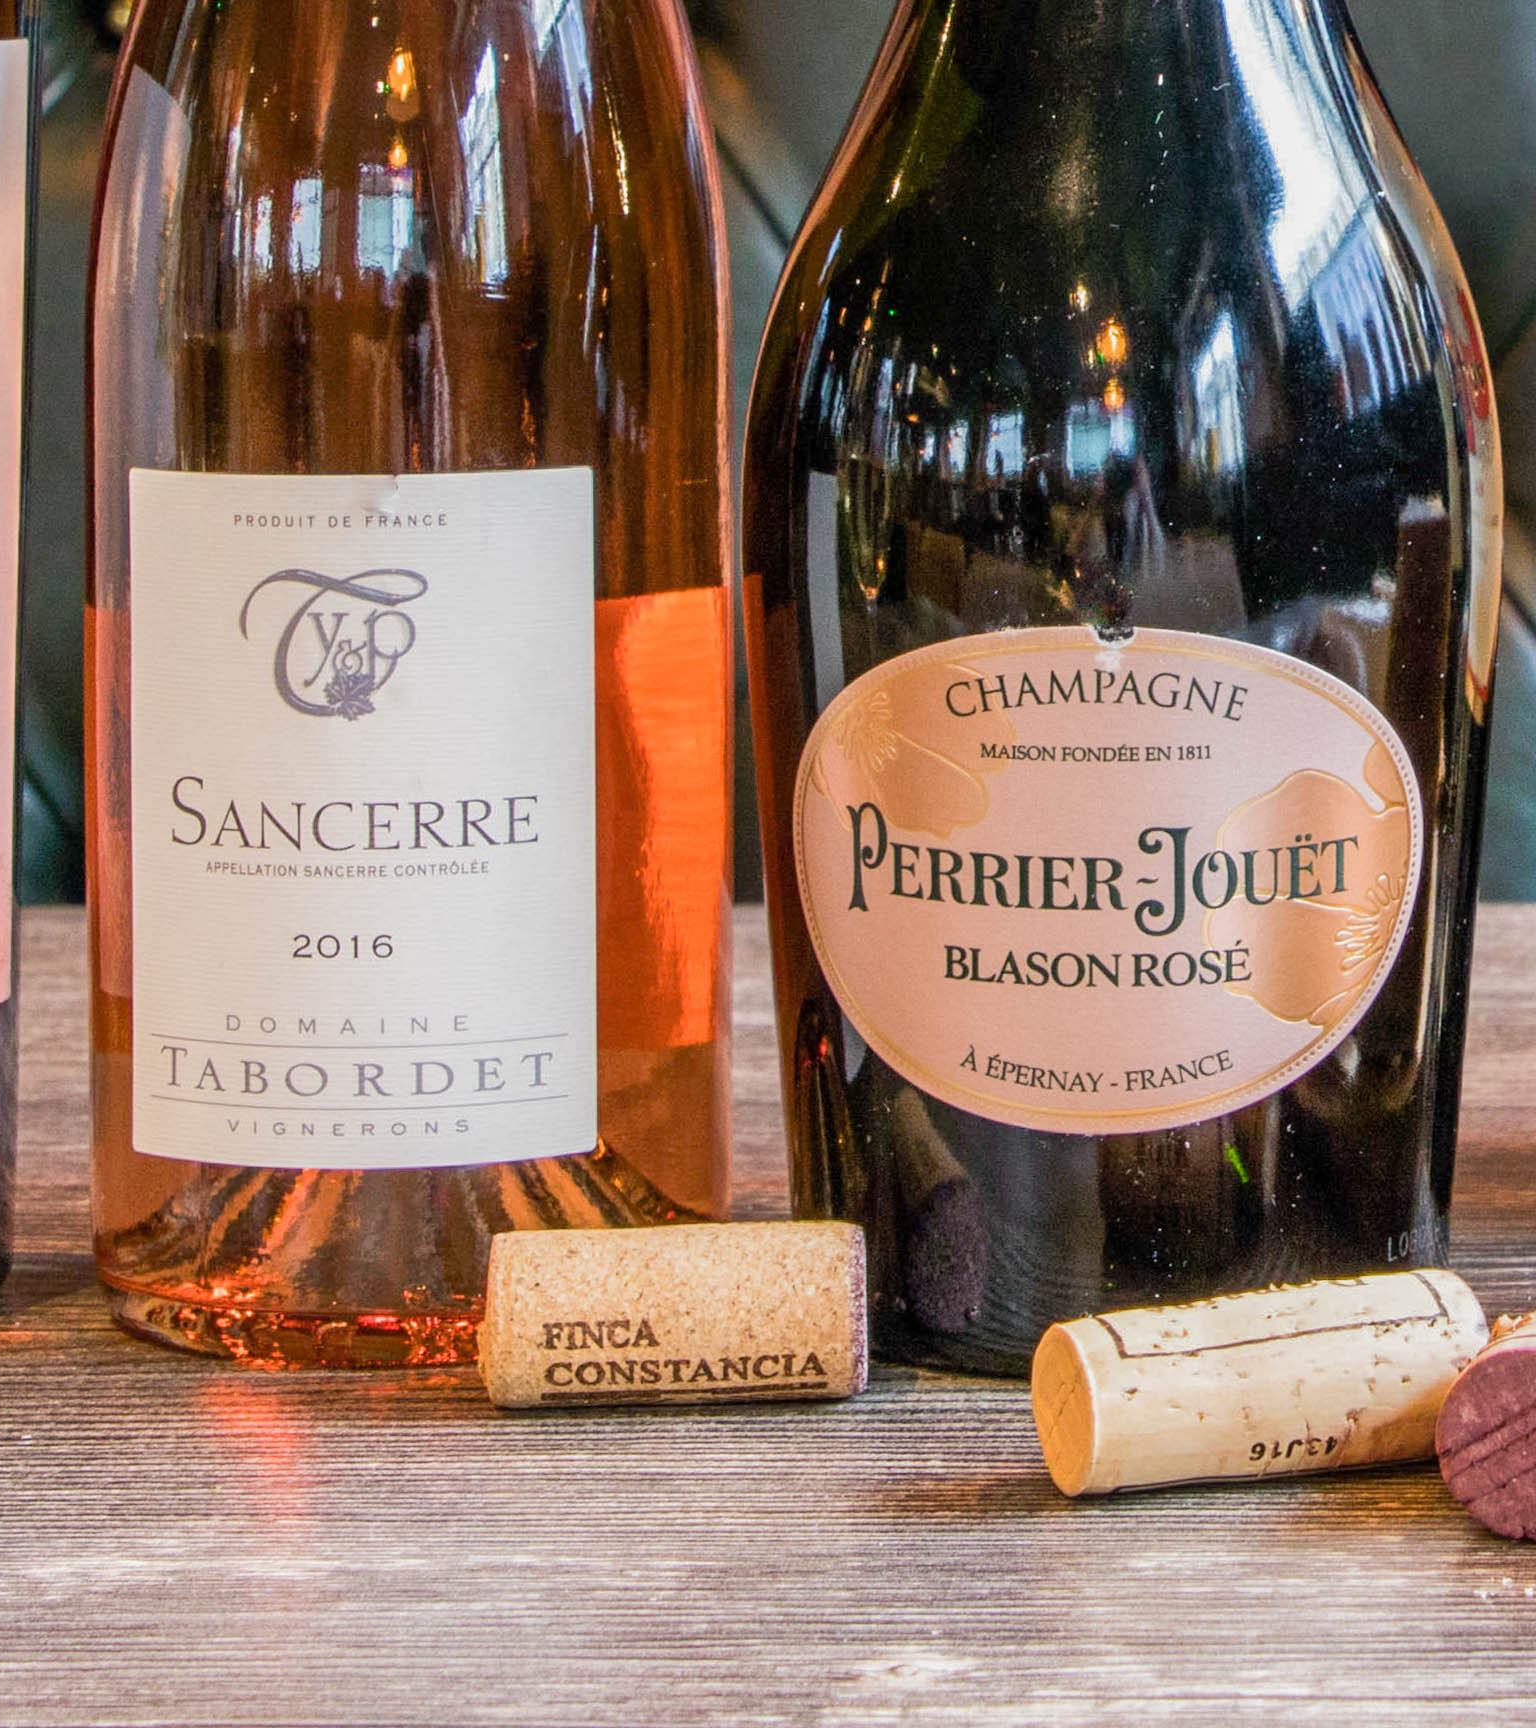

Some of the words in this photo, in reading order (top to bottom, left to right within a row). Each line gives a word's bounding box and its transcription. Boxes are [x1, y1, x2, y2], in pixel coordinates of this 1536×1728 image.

[234, 514, 315, 528] PRODUIT
[328, 515, 351, 528] DE
[365, 514, 448, 527] FRANCE
[945, 668, 1249, 722] CHAMPAGNE
[980, 743, 1056, 762] MAISON
[1062, 743, 1140, 762] FONDÉE
[1145, 746, 1172, 761] EN
[1178, 745, 1211, 760] 1811
[170, 776, 540, 851] SANCERRE
[206, 860, 297, 877] APPELLATION
[303, 864, 387, 878] SANCERRE
[394, 860, 490, 877] CONTRÔLÉE
[847, 801, 1359, 937] PERRIER-JOUËT
[292, 934, 394, 959] 2016
[944, 944, 1122, 987] BLASON
[1131, 939, 1253, 987] ROSÉ
[227, 1014, 469, 1035] DOMAINE
[160, 1045, 554, 1097] TABORDET
[960, 1043, 978, 1072] À
[985, 1053, 1104, 1093] ÉPERNAY
[1124, 1049, 1234, 1092] FRANCE
[227, 1118, 471, 1137] VIGNERONS
[541, 1318, 661, 1351] FINCA
[544, 1351, 828, 1387] CONSTANCIA
